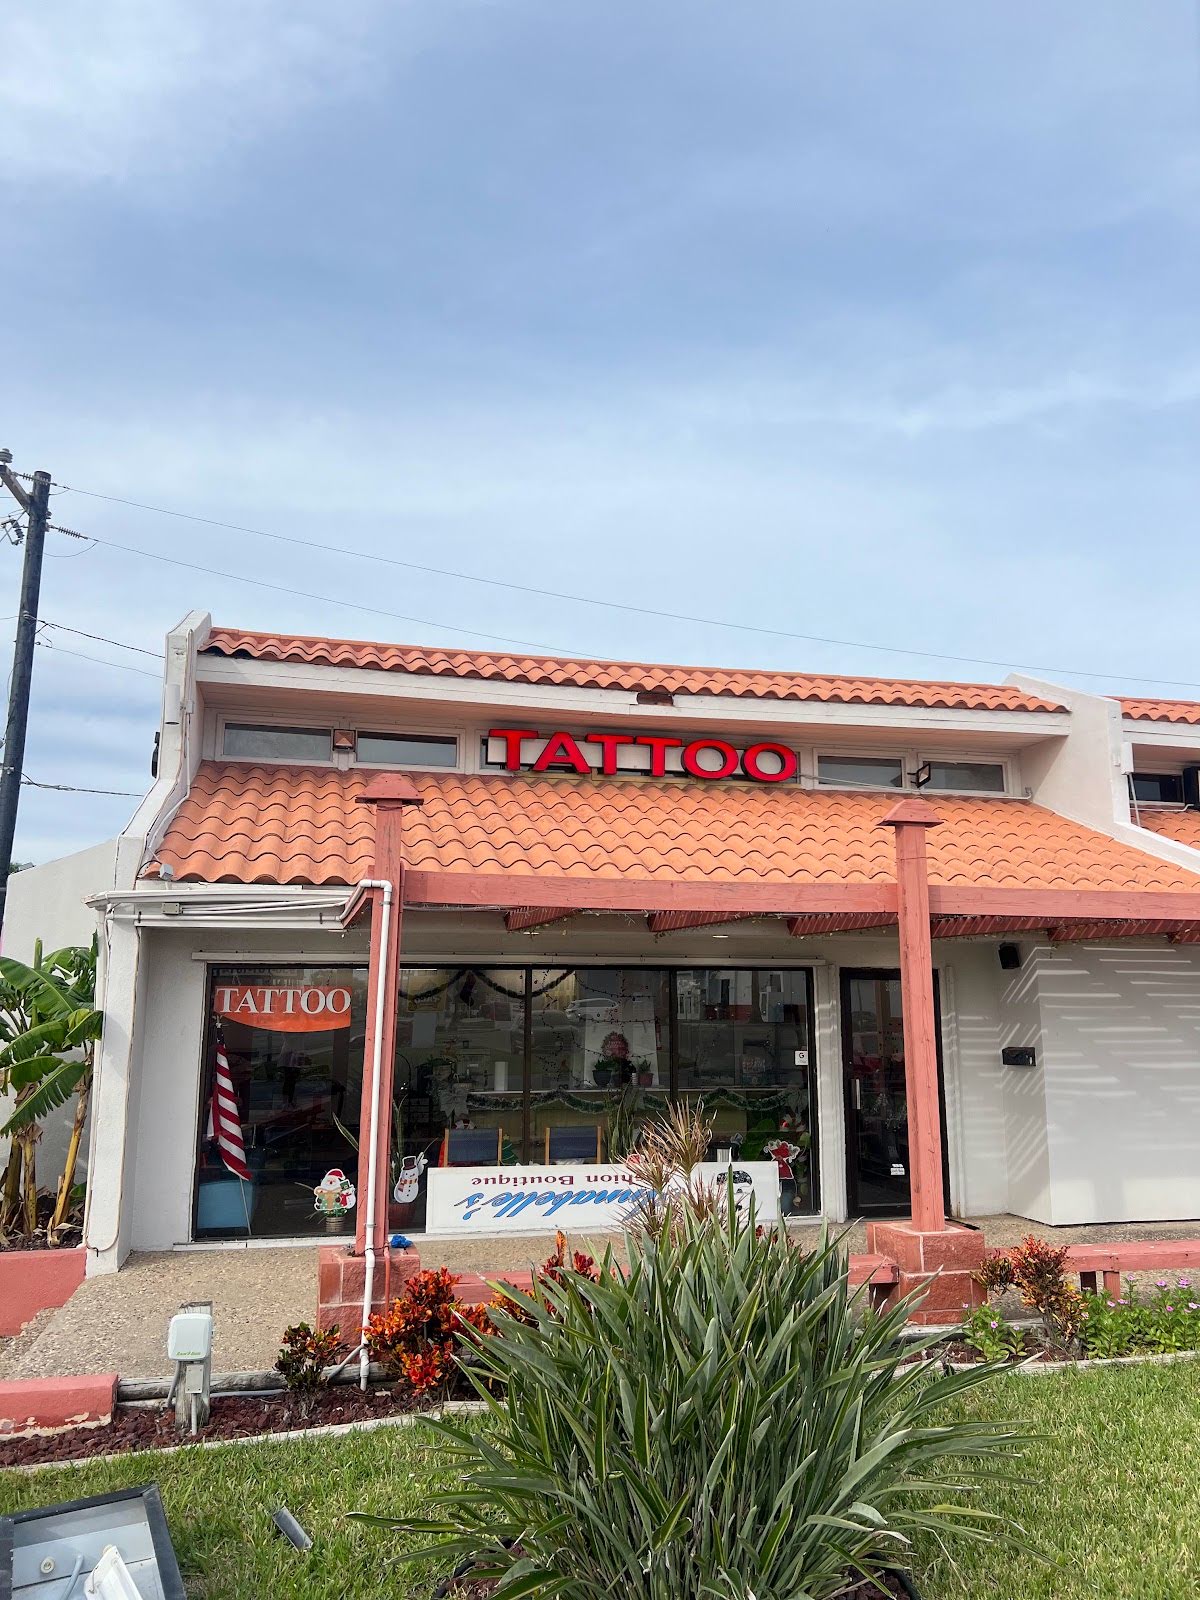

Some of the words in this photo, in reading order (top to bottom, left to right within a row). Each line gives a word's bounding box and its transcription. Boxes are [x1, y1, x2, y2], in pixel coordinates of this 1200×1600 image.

[487, 729, 797, 782] TATTOO
[215, 988, 352, 1014] TATTOO
[471, 1174, 574, 1187] Boutique
[584, 1173, 656, 1186] hion
